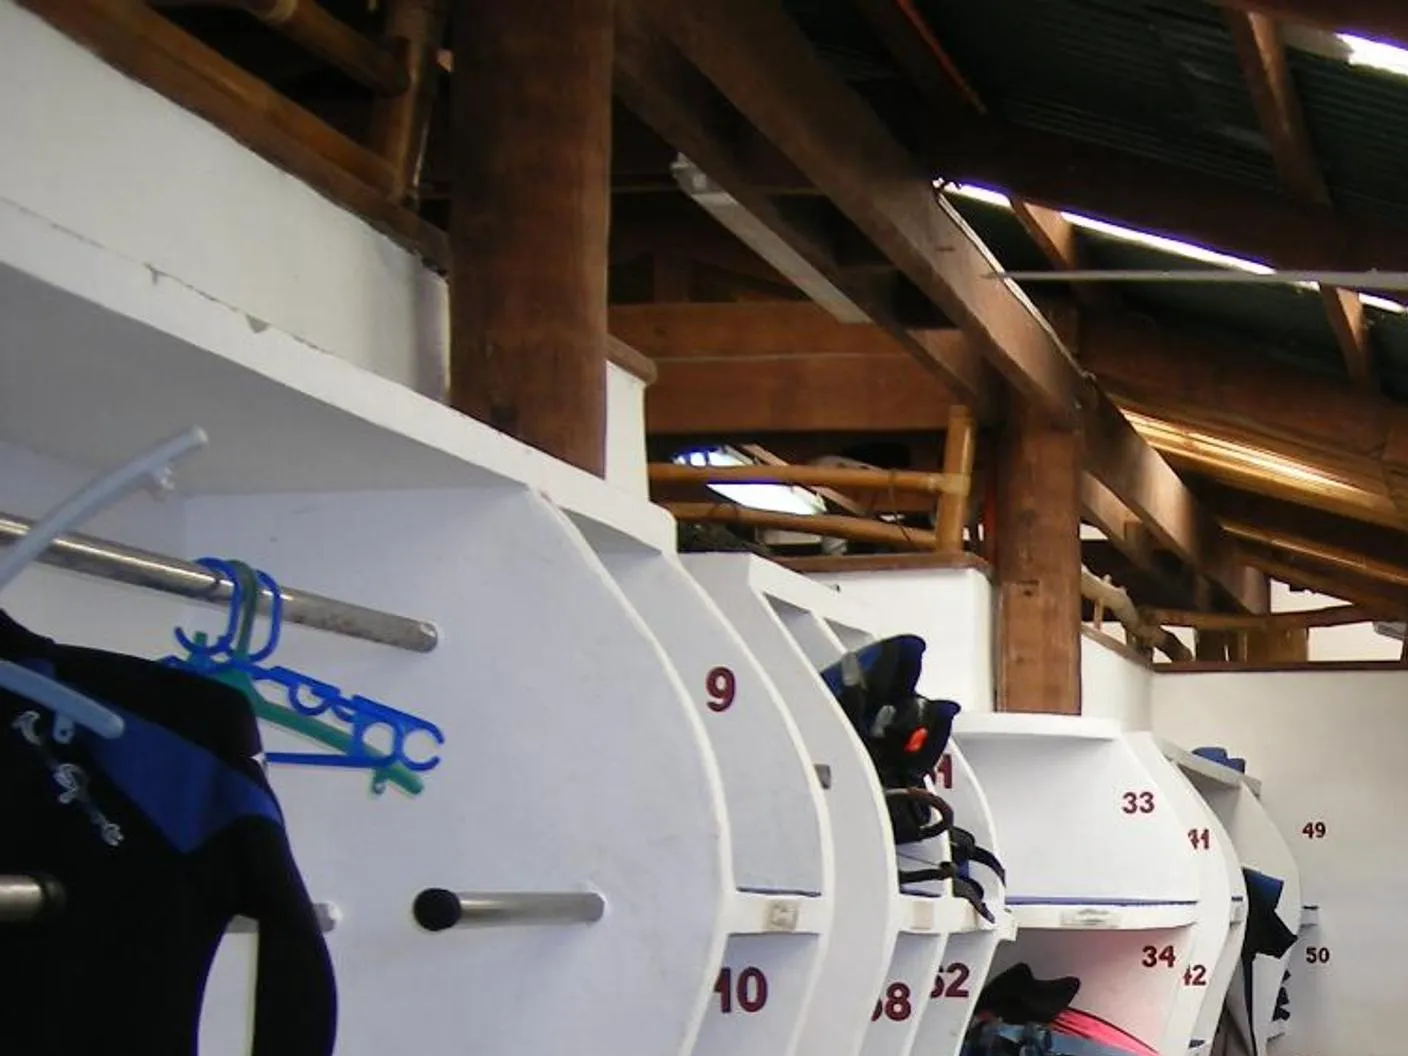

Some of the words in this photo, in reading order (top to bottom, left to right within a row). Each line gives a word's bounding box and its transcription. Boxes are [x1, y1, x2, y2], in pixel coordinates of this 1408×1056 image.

[706, 667, 736, 712] 9
[929, 753, 952, 790] 1
[1123, 792, 1154, 814] 33
[1302, 822, 1326, 839] 49
[1142, 945, 1175, 967] 34
[1306, 947, 1329, 964] 50
[714, 966, 767, 1013] 10
[872, 984, 912, 1022] 8
